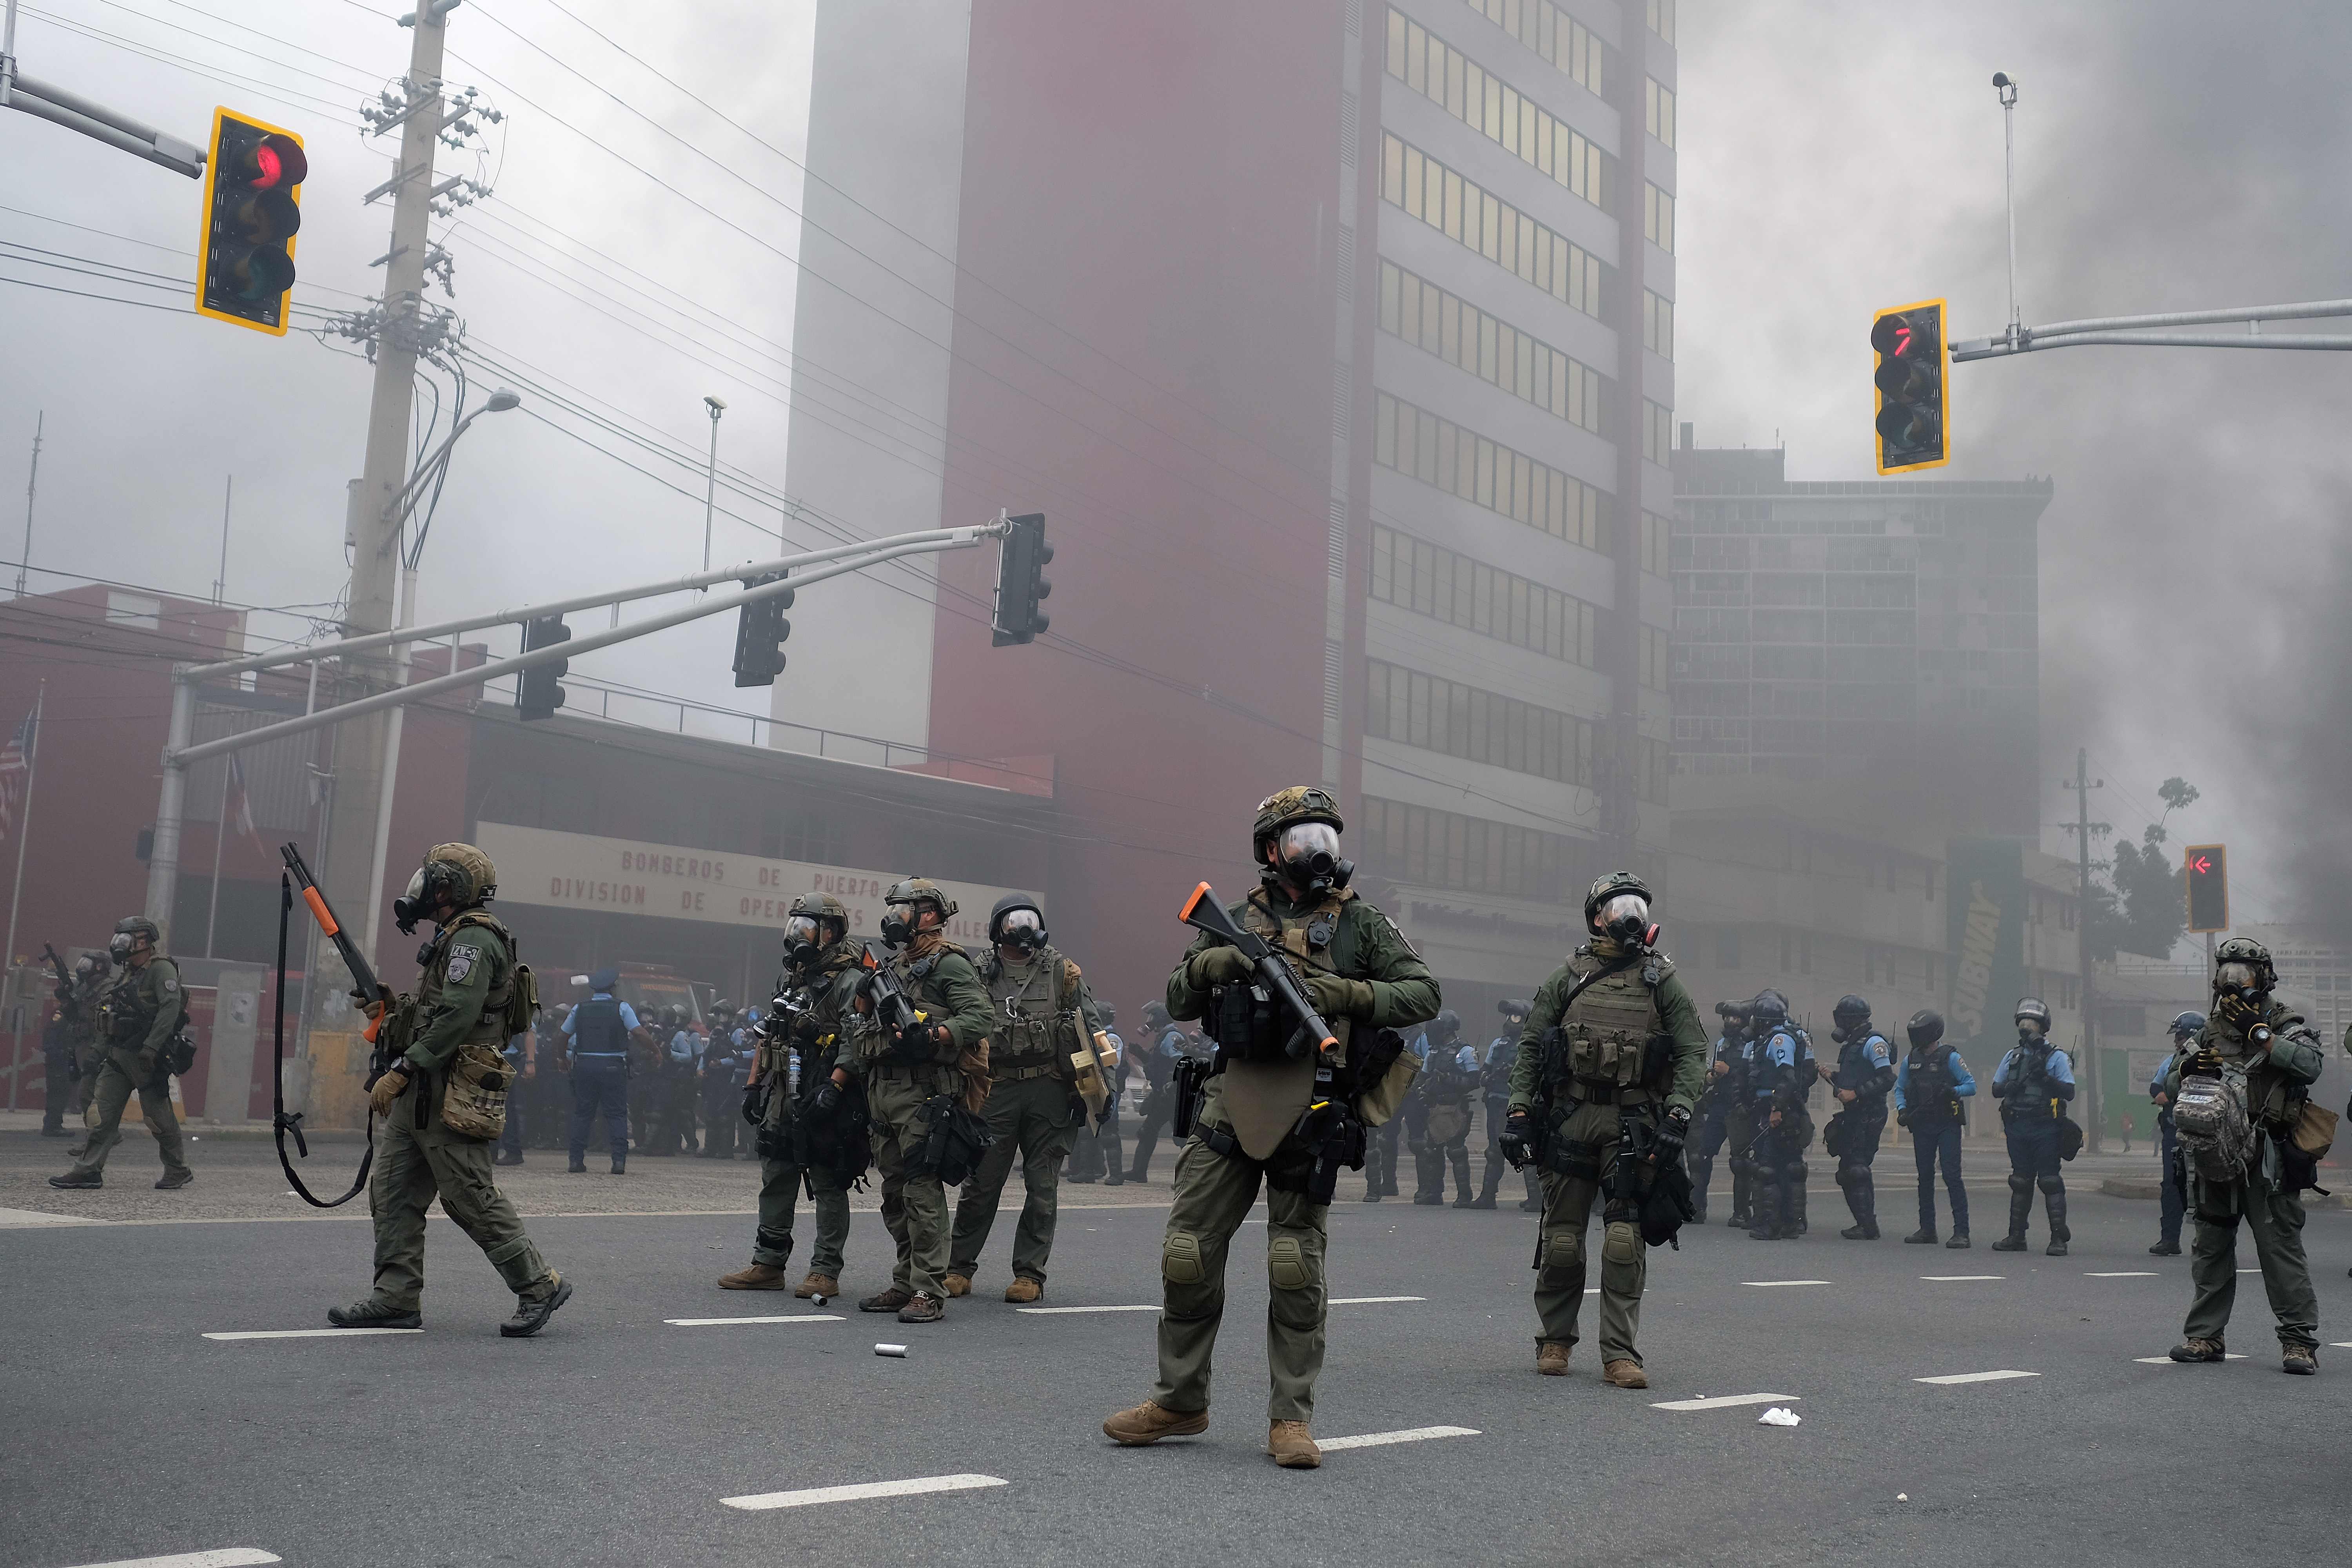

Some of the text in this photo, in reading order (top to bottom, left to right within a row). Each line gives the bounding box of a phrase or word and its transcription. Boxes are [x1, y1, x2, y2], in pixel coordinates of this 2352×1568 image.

[550, 876, 646, 904] DIVISION
[682, 890, 705, 911] DE
[622, 850, 879, 897] BOMBEROS DE PUERTO
[453, 945, 477, 958] ZW-3
[1951, 879, 2001, 1037] SUBWAY
